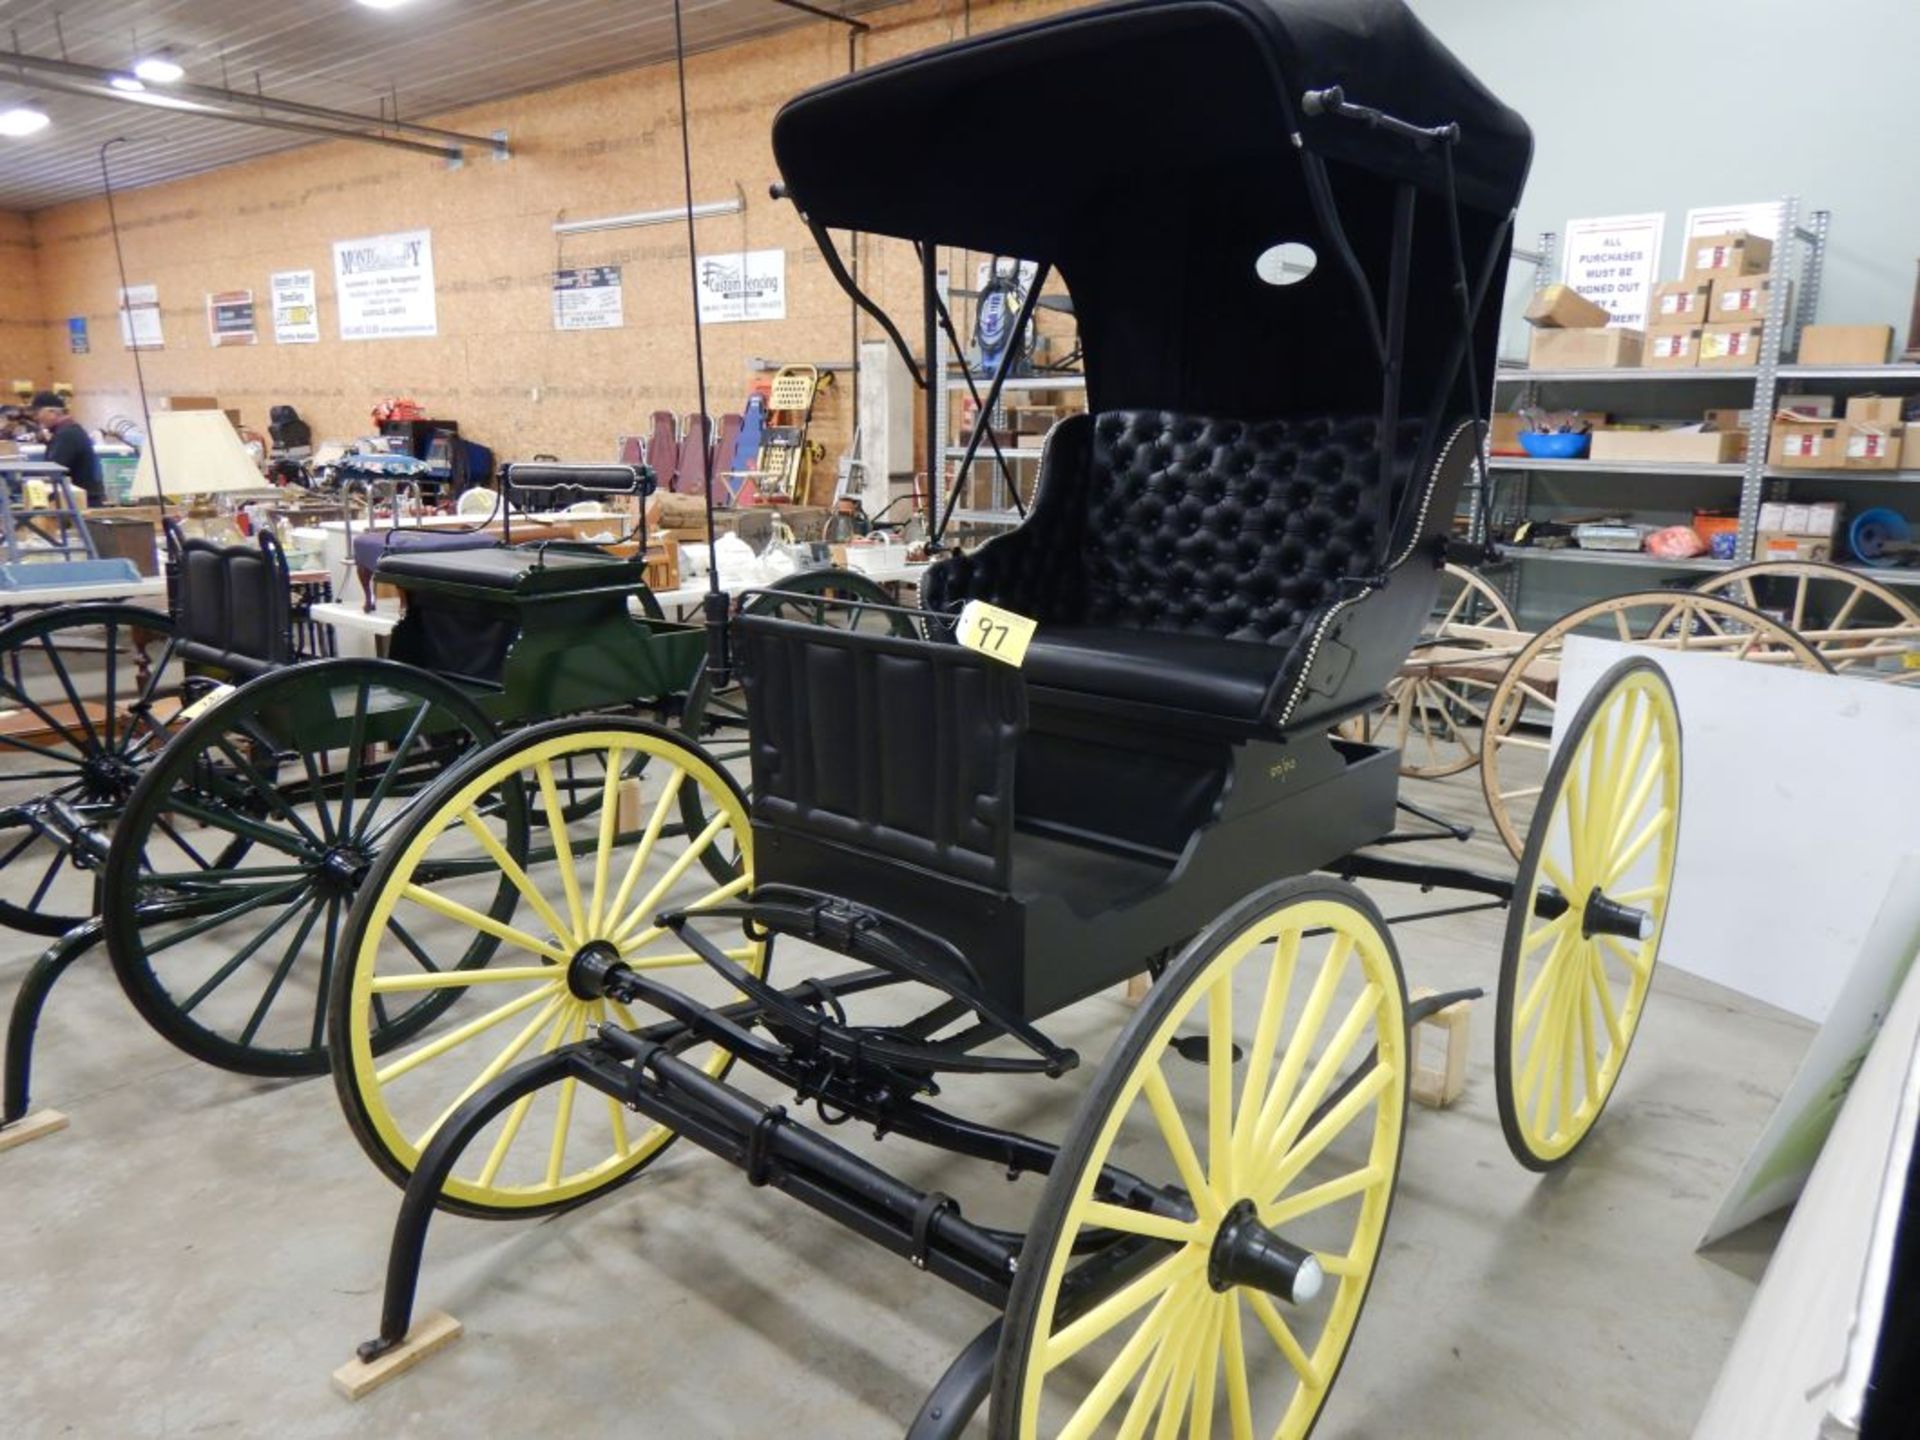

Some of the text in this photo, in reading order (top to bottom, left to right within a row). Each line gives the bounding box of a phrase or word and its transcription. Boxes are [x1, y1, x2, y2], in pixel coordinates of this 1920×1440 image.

[1603, 238, 1622, 247] ALL
[1579, 251, 1644, 264] PURCHASES
[1586, 267, 1633, 278] MUST BE
[1576, 282, 1641, 294] SIGNED OUT
[979, 617, 1009, 651] 97
